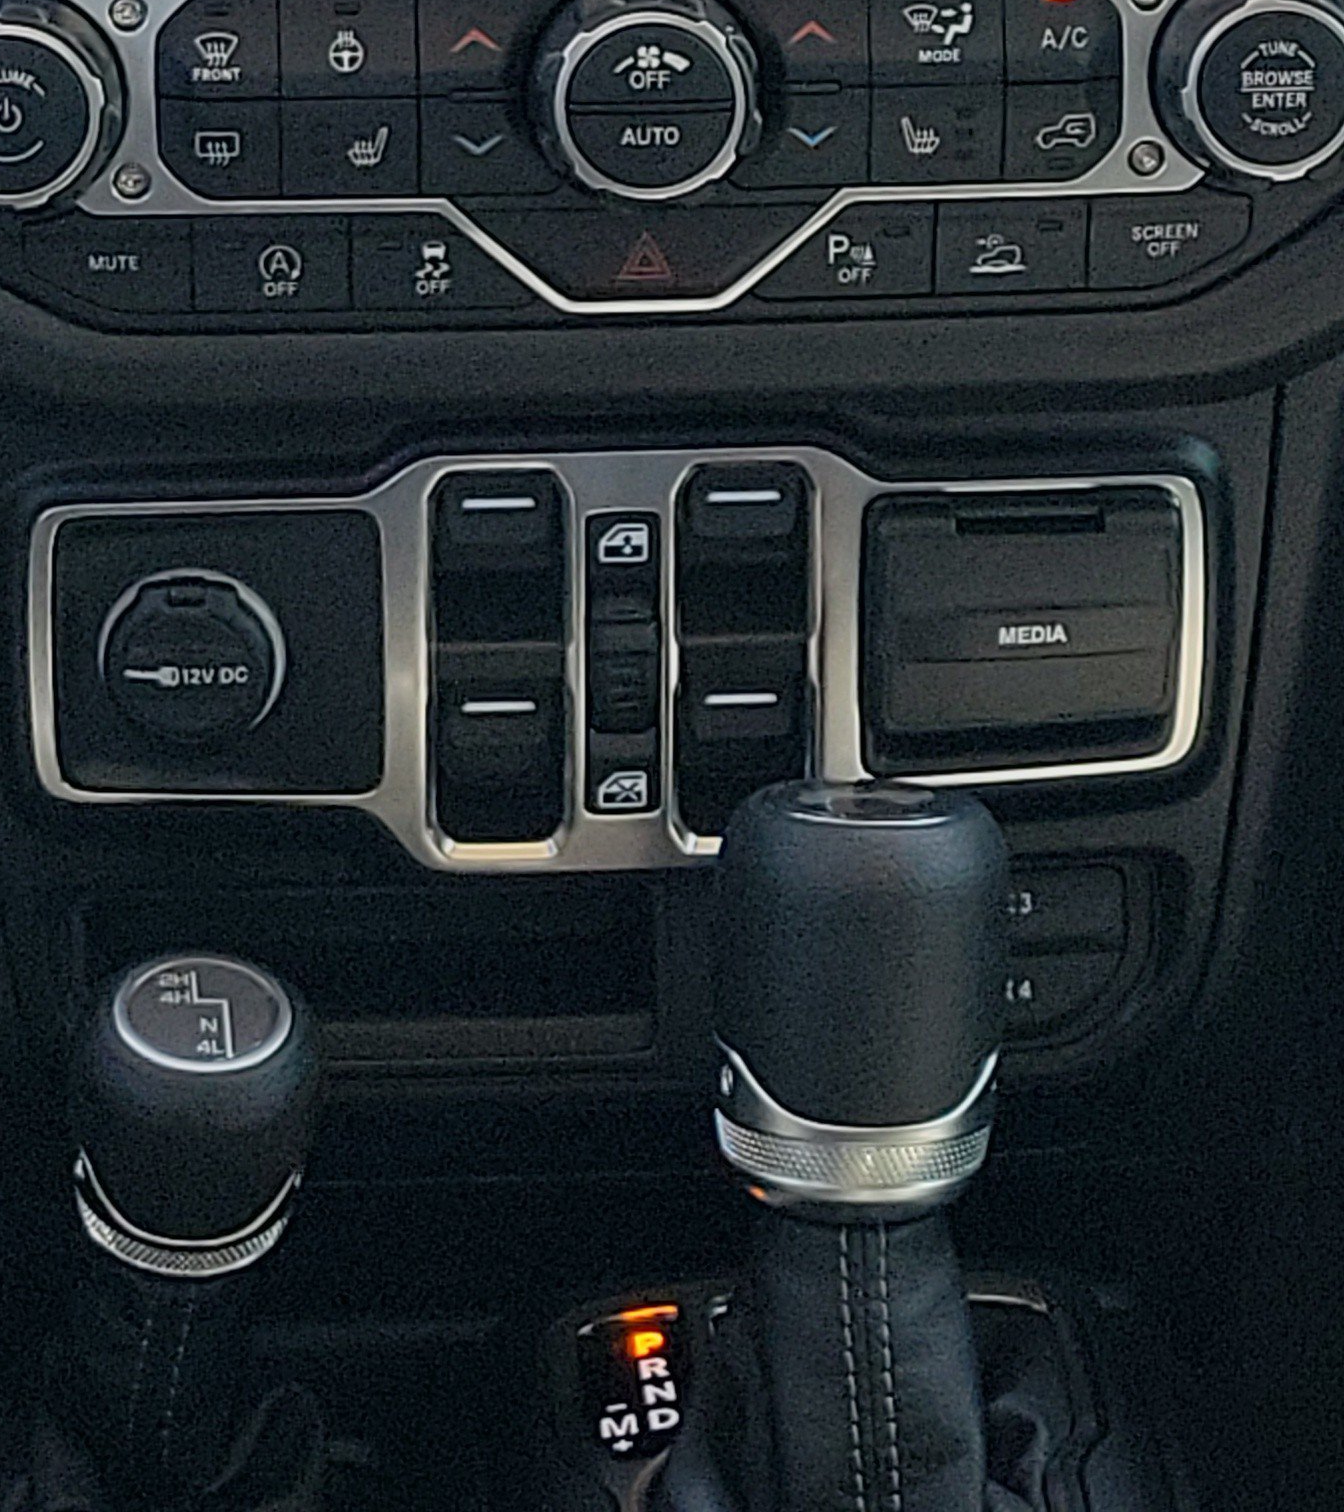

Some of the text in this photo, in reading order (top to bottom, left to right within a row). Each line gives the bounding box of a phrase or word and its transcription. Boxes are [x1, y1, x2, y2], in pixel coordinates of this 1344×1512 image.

[1041, 25, 1089, 50] A/C
[918, 48, 961, 63] MODE
[1258, 40, 1299, 57] TUNE
[192, 67, 241, 82] FRONT
[629, 70, 671, 90] OFF
[1241, 70, 1314, 87] BROWSE
[1252, 92, 1307, 109] ENTER
[620, 126, 681, 146] AUTO
[1250, 118, 1307, 136] SCROLL
[1131, 222, 1199, 242] SCREEN
[1147, 240, 1181, 258] OFF
[88, 254, 139, 271] MUTE
[838, 267, 873, 284] OFF
[263, 281, 298, 297] OFF
[415, 279, 451, 296] OFF
[998, 623, 1068, 645] MEDIA
[182, 666, 249, 685] 12V DC
[159, 990, 191, 1004] 4H
[199, 1017, 218, 1033] N
[196, 1040, 226, 1055] 4L
[632, 1331, 664, 1357] P
[638, 1357, 670, 1380] R
[642, 1380, 677, 1405] N
[599, 1413, 639, 1438] M
[647, 1407, 680, 1431] D
